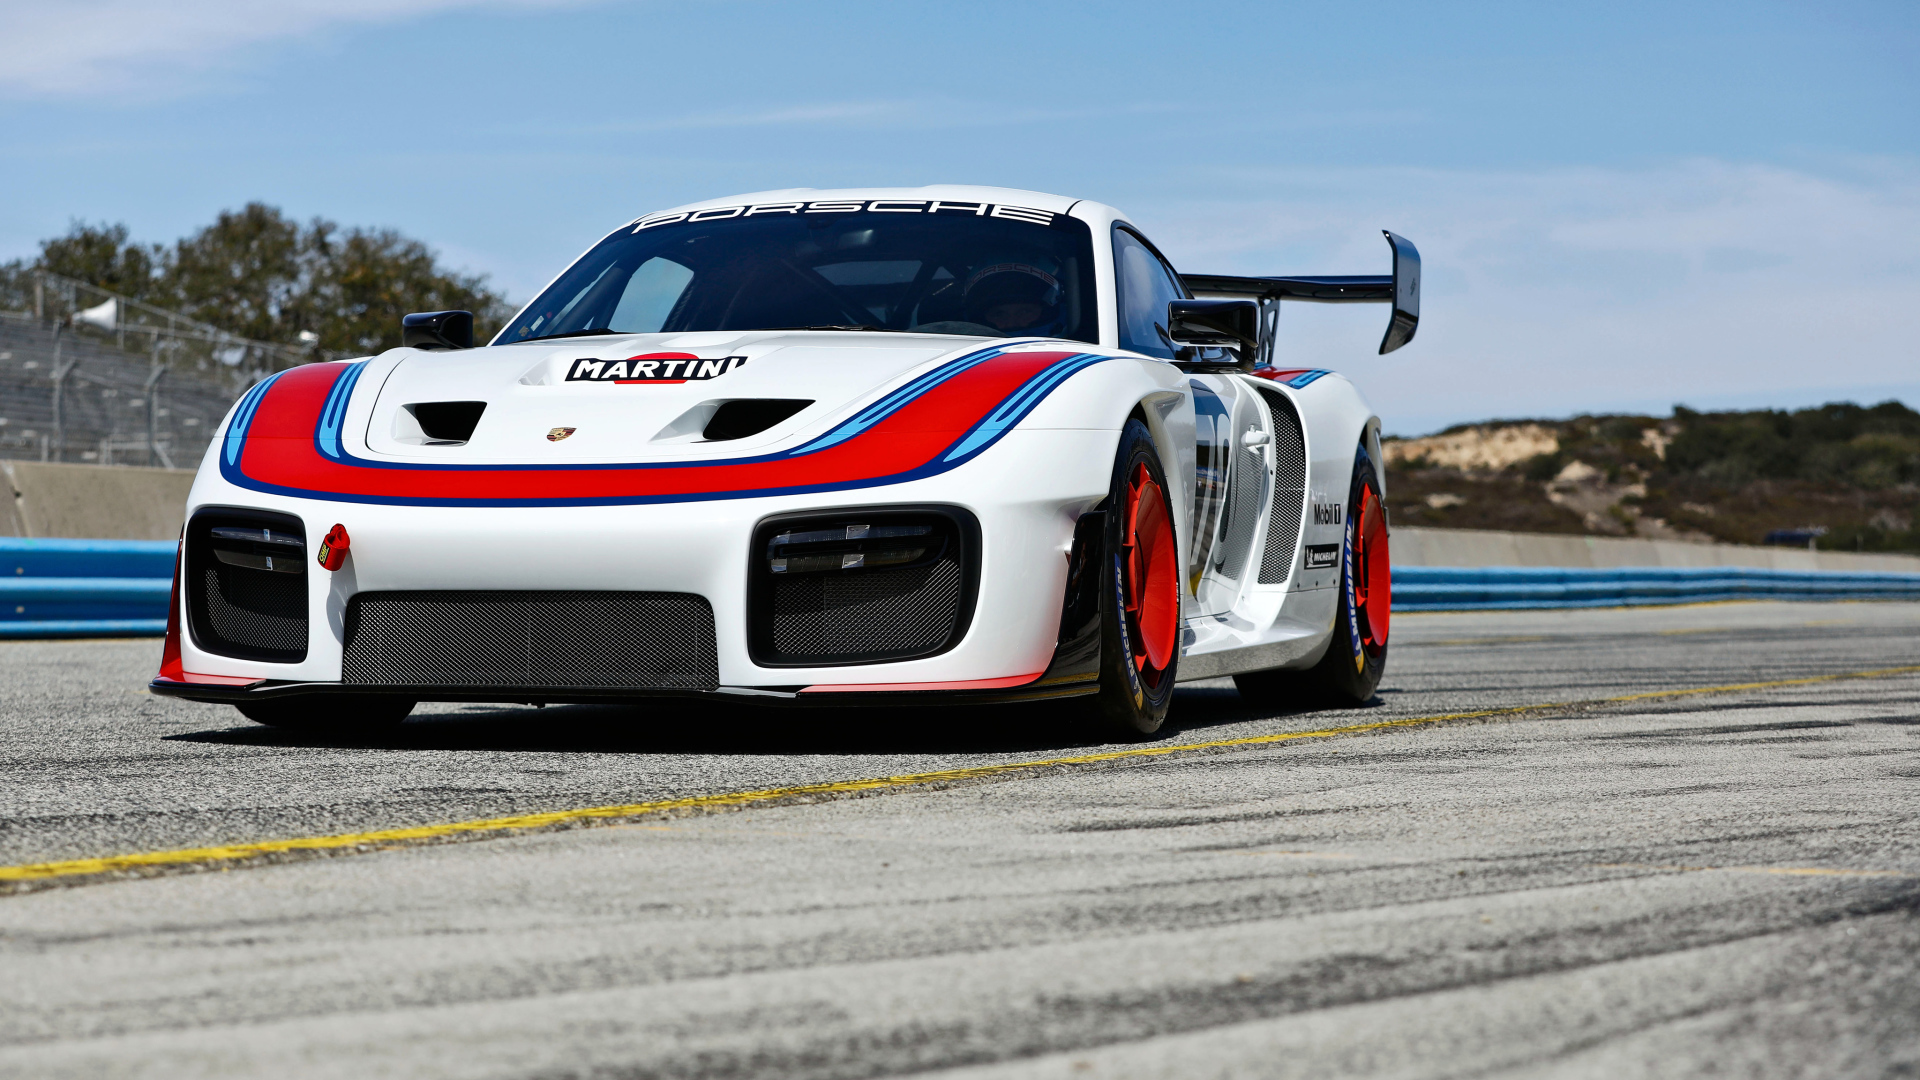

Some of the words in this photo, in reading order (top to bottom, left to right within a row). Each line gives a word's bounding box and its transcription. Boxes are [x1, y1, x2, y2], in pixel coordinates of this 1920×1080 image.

[631, 201, 1055, 234] PORSCHE
[572, 358, 740, 378] MARTINI
[1314, 504, 1333, 525] Mobil
[1314, 551, 1337, 562] MICHELIN
[1346, 523, 1358, 636] MICHELIN
[1116, 566, 1135, 677] MICHELIN
